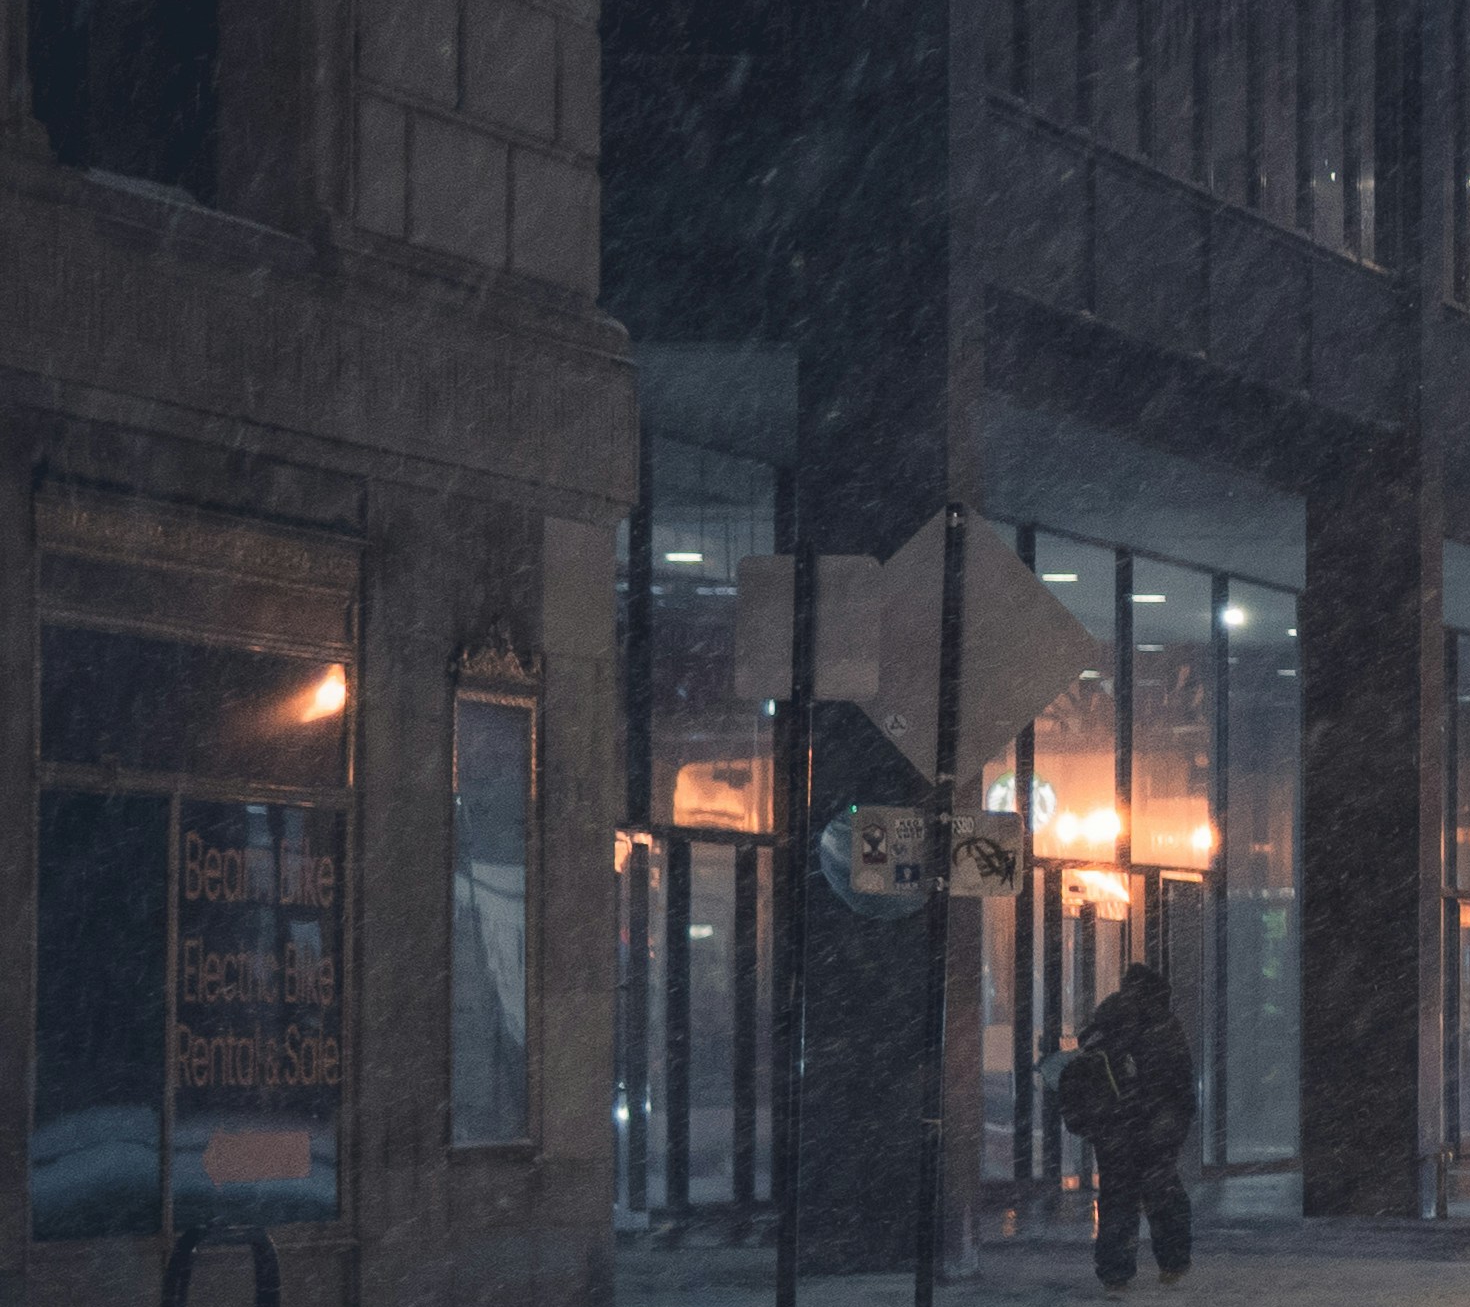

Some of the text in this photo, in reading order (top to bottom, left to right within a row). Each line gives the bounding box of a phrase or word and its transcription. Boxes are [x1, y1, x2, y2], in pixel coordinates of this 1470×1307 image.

[183, 936, 336, 1007] Electric Bike
[176, 1022, 262, 1088] Rental
[284, 1022, 341, 1088] Sale
